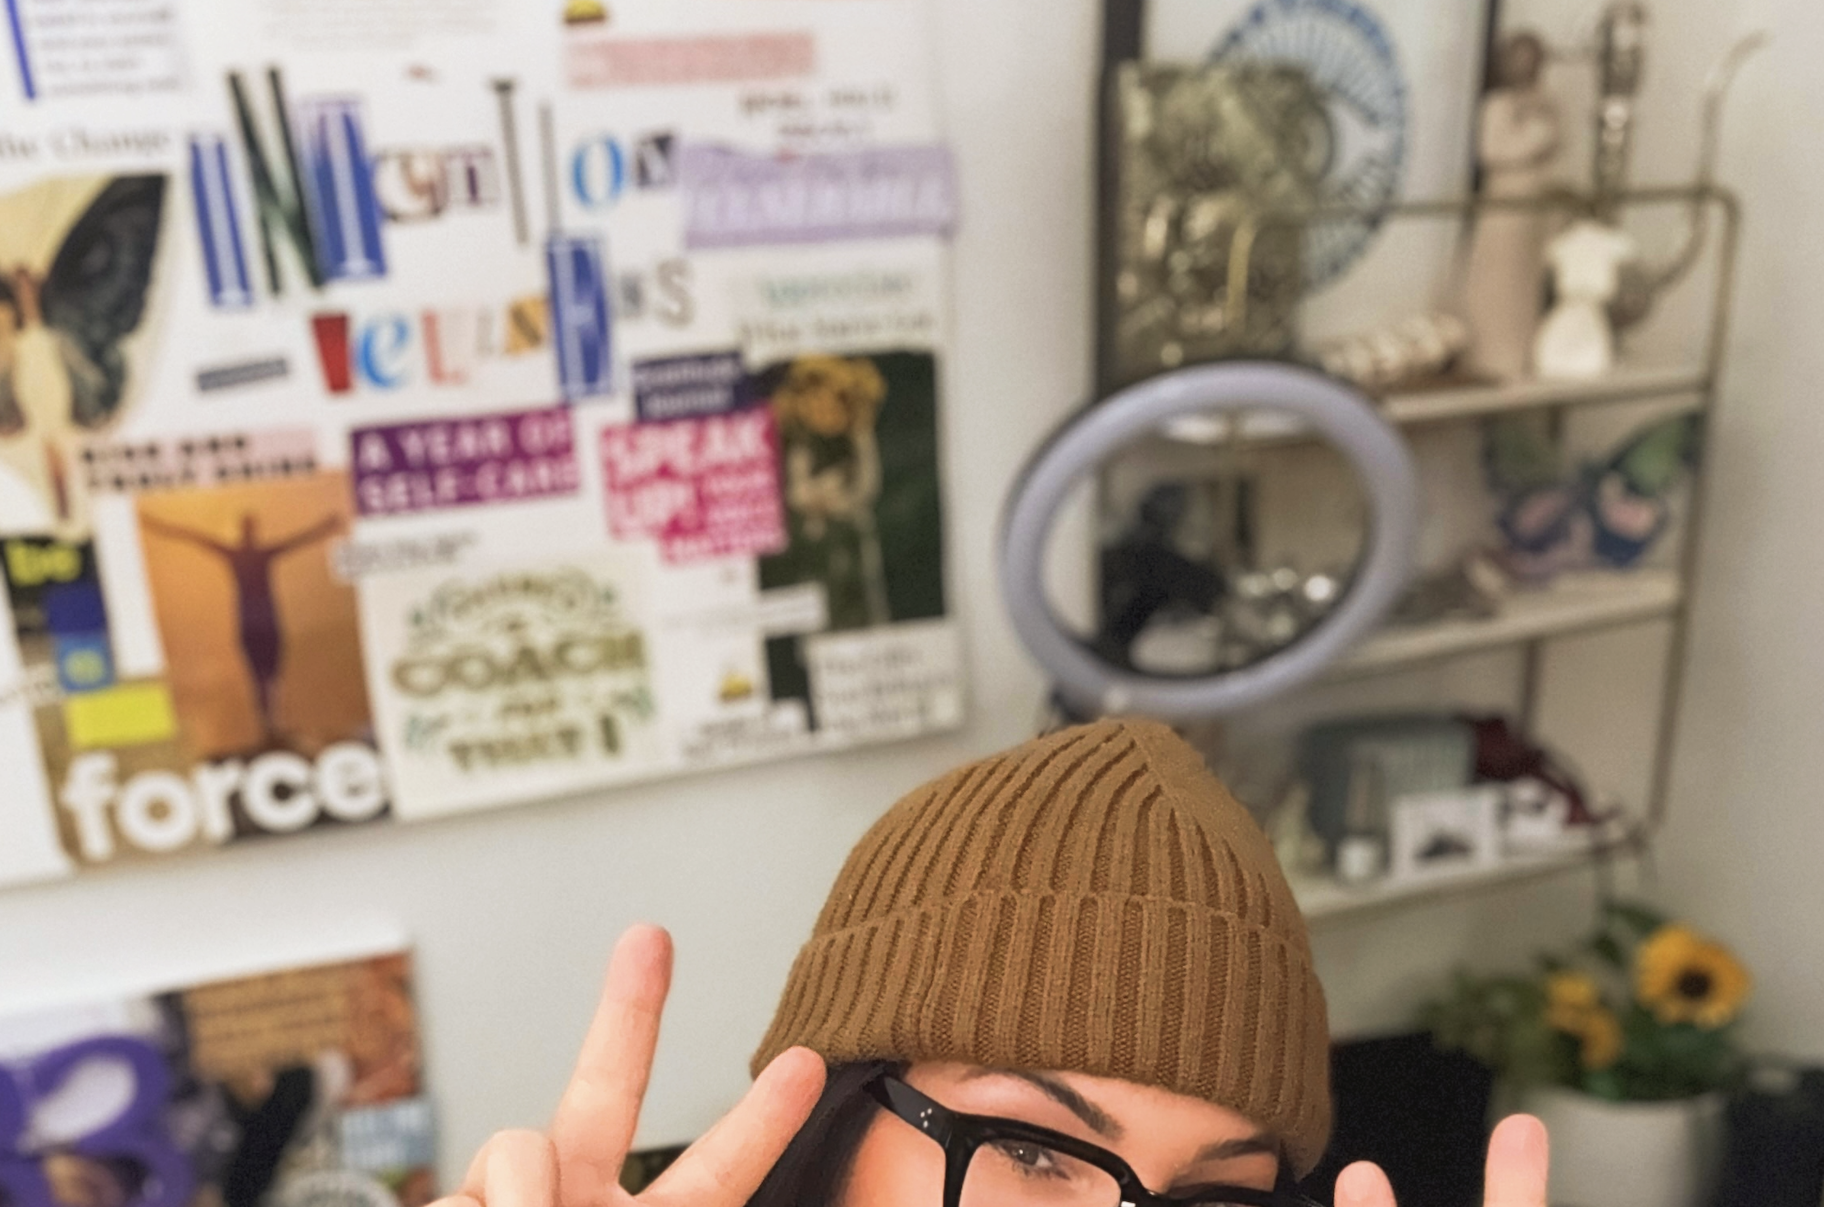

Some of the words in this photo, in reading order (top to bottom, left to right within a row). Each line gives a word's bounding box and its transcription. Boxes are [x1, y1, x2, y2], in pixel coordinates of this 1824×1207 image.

[358, 431, 392, 471] A
[400, 420, 512, 468] YEAR
[605, 411, 769, 482] SPEAK
[62, 741, 386, 861] force
